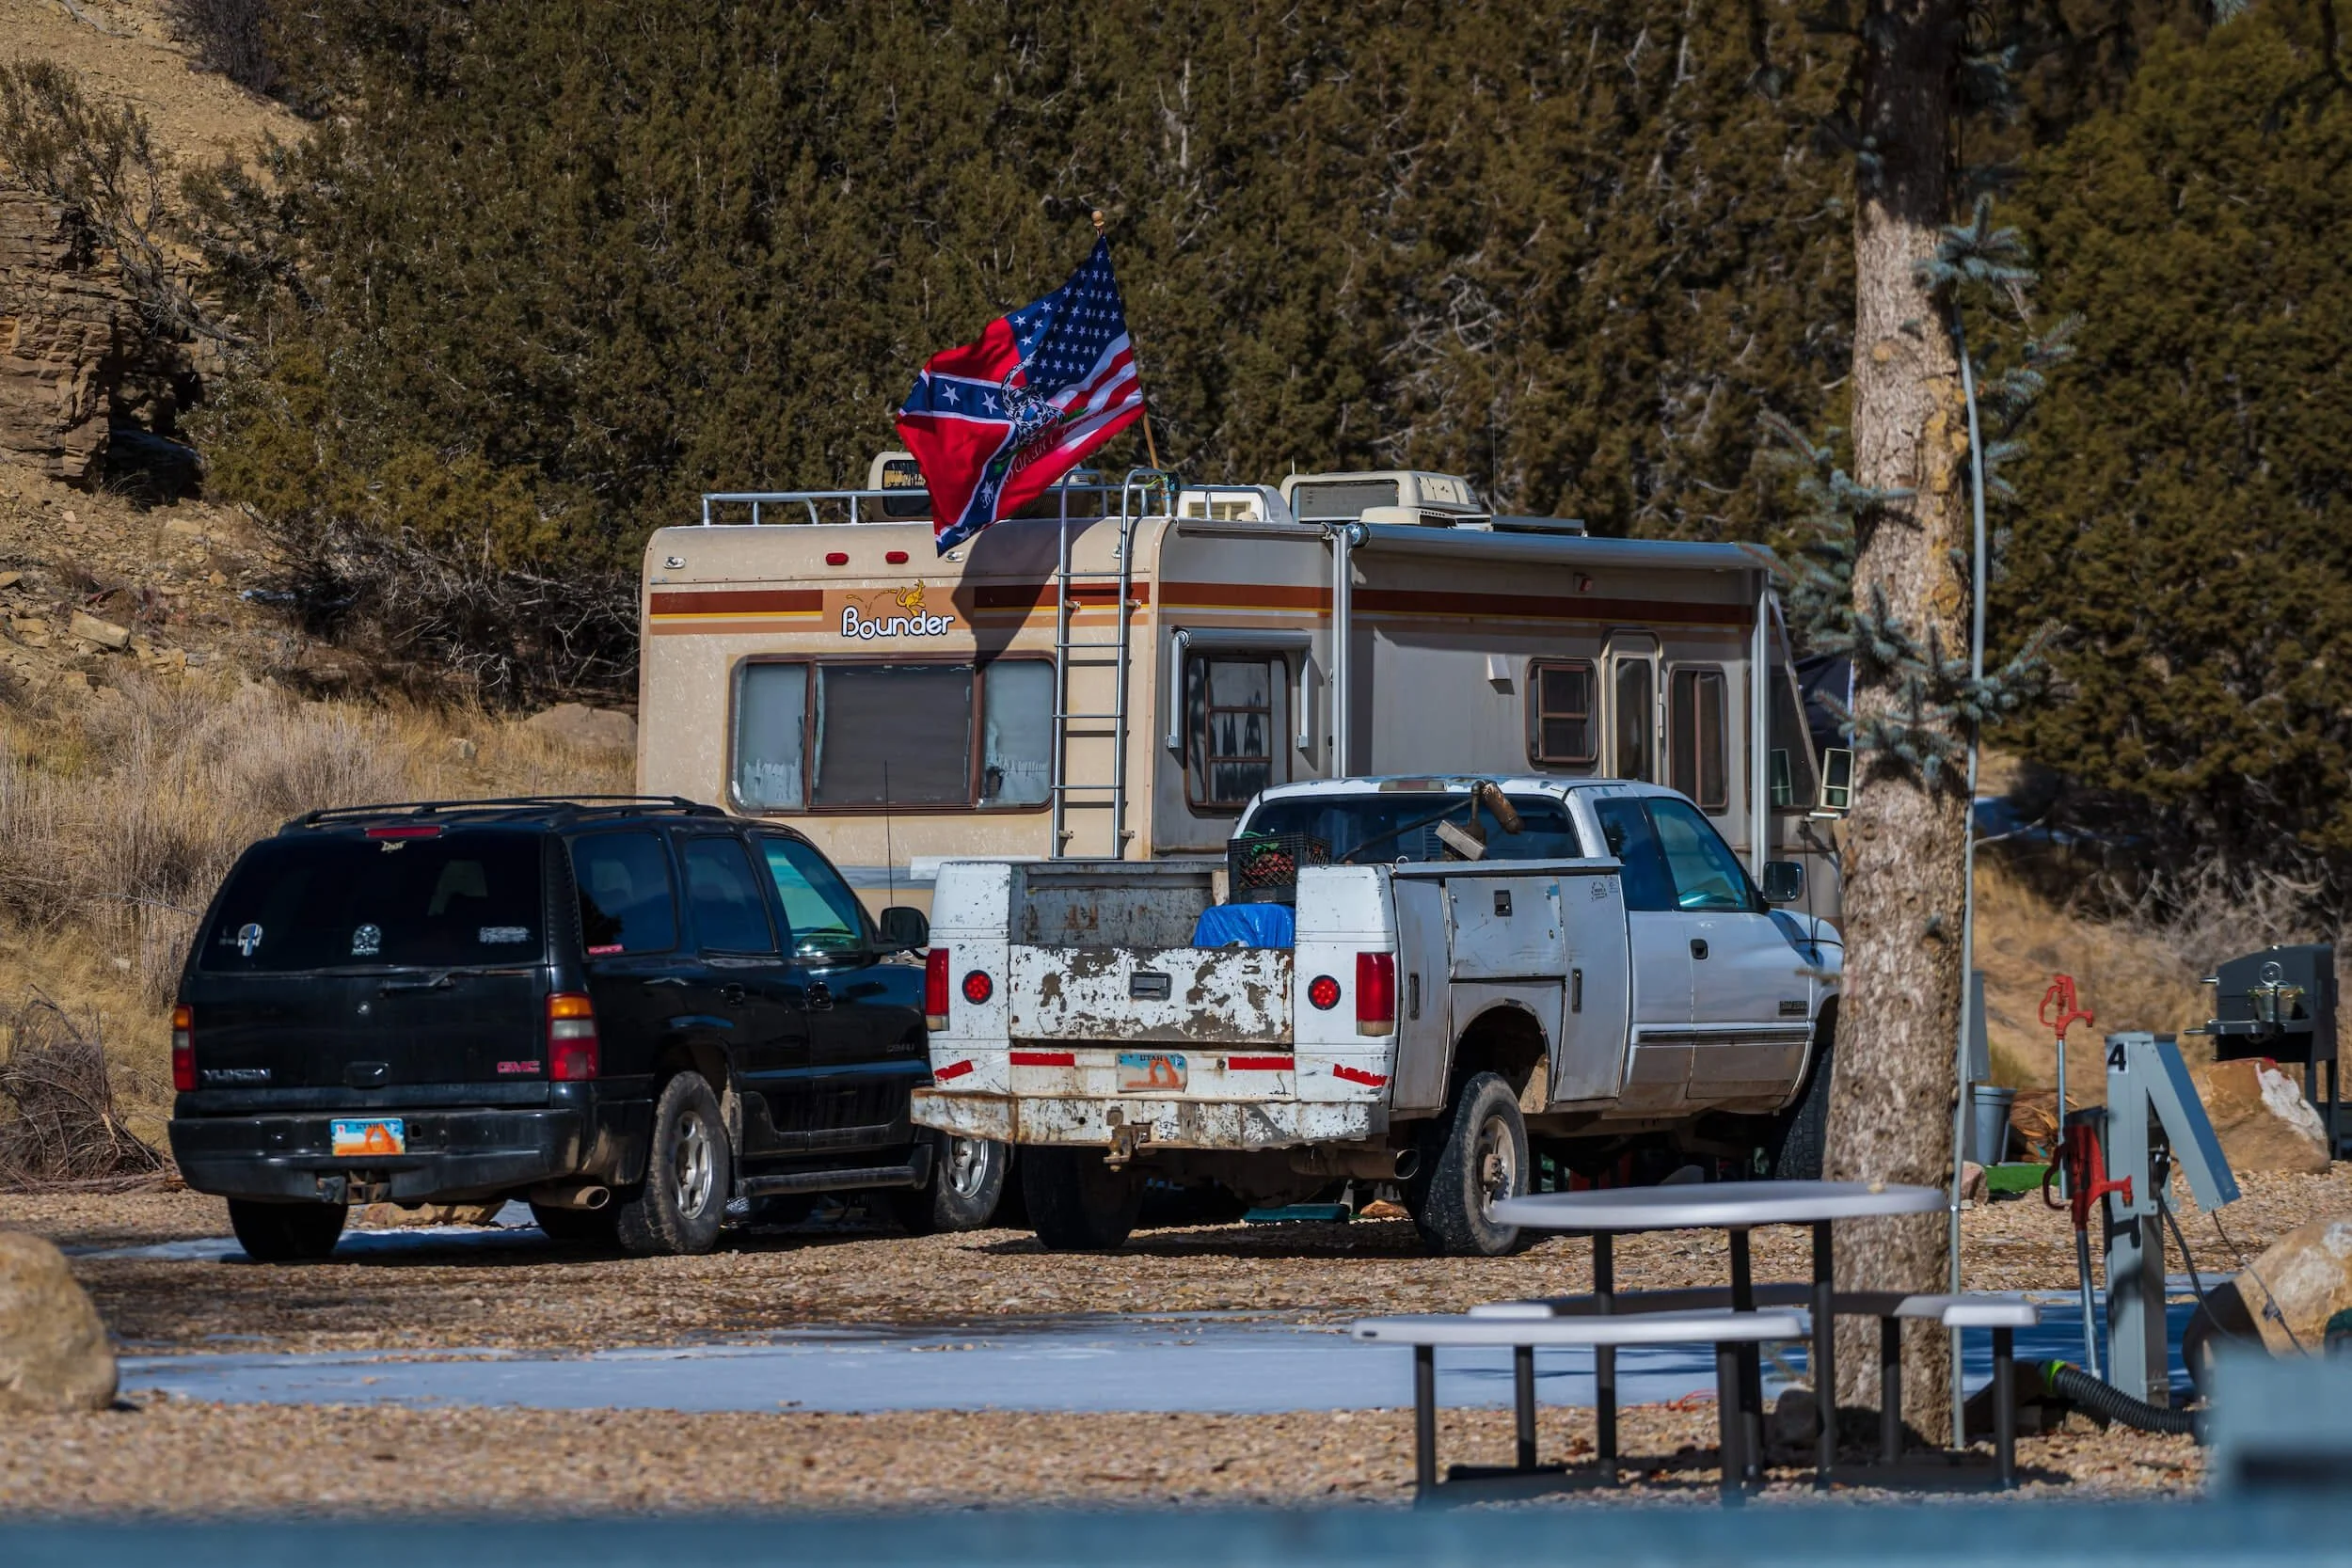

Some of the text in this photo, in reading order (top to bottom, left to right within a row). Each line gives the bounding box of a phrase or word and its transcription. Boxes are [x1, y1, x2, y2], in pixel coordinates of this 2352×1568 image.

[841, 605, 956, 641] Bounder
[497, 1060, 541, 1073] GMC
[2107, 1043, 2127, 1071] 4
